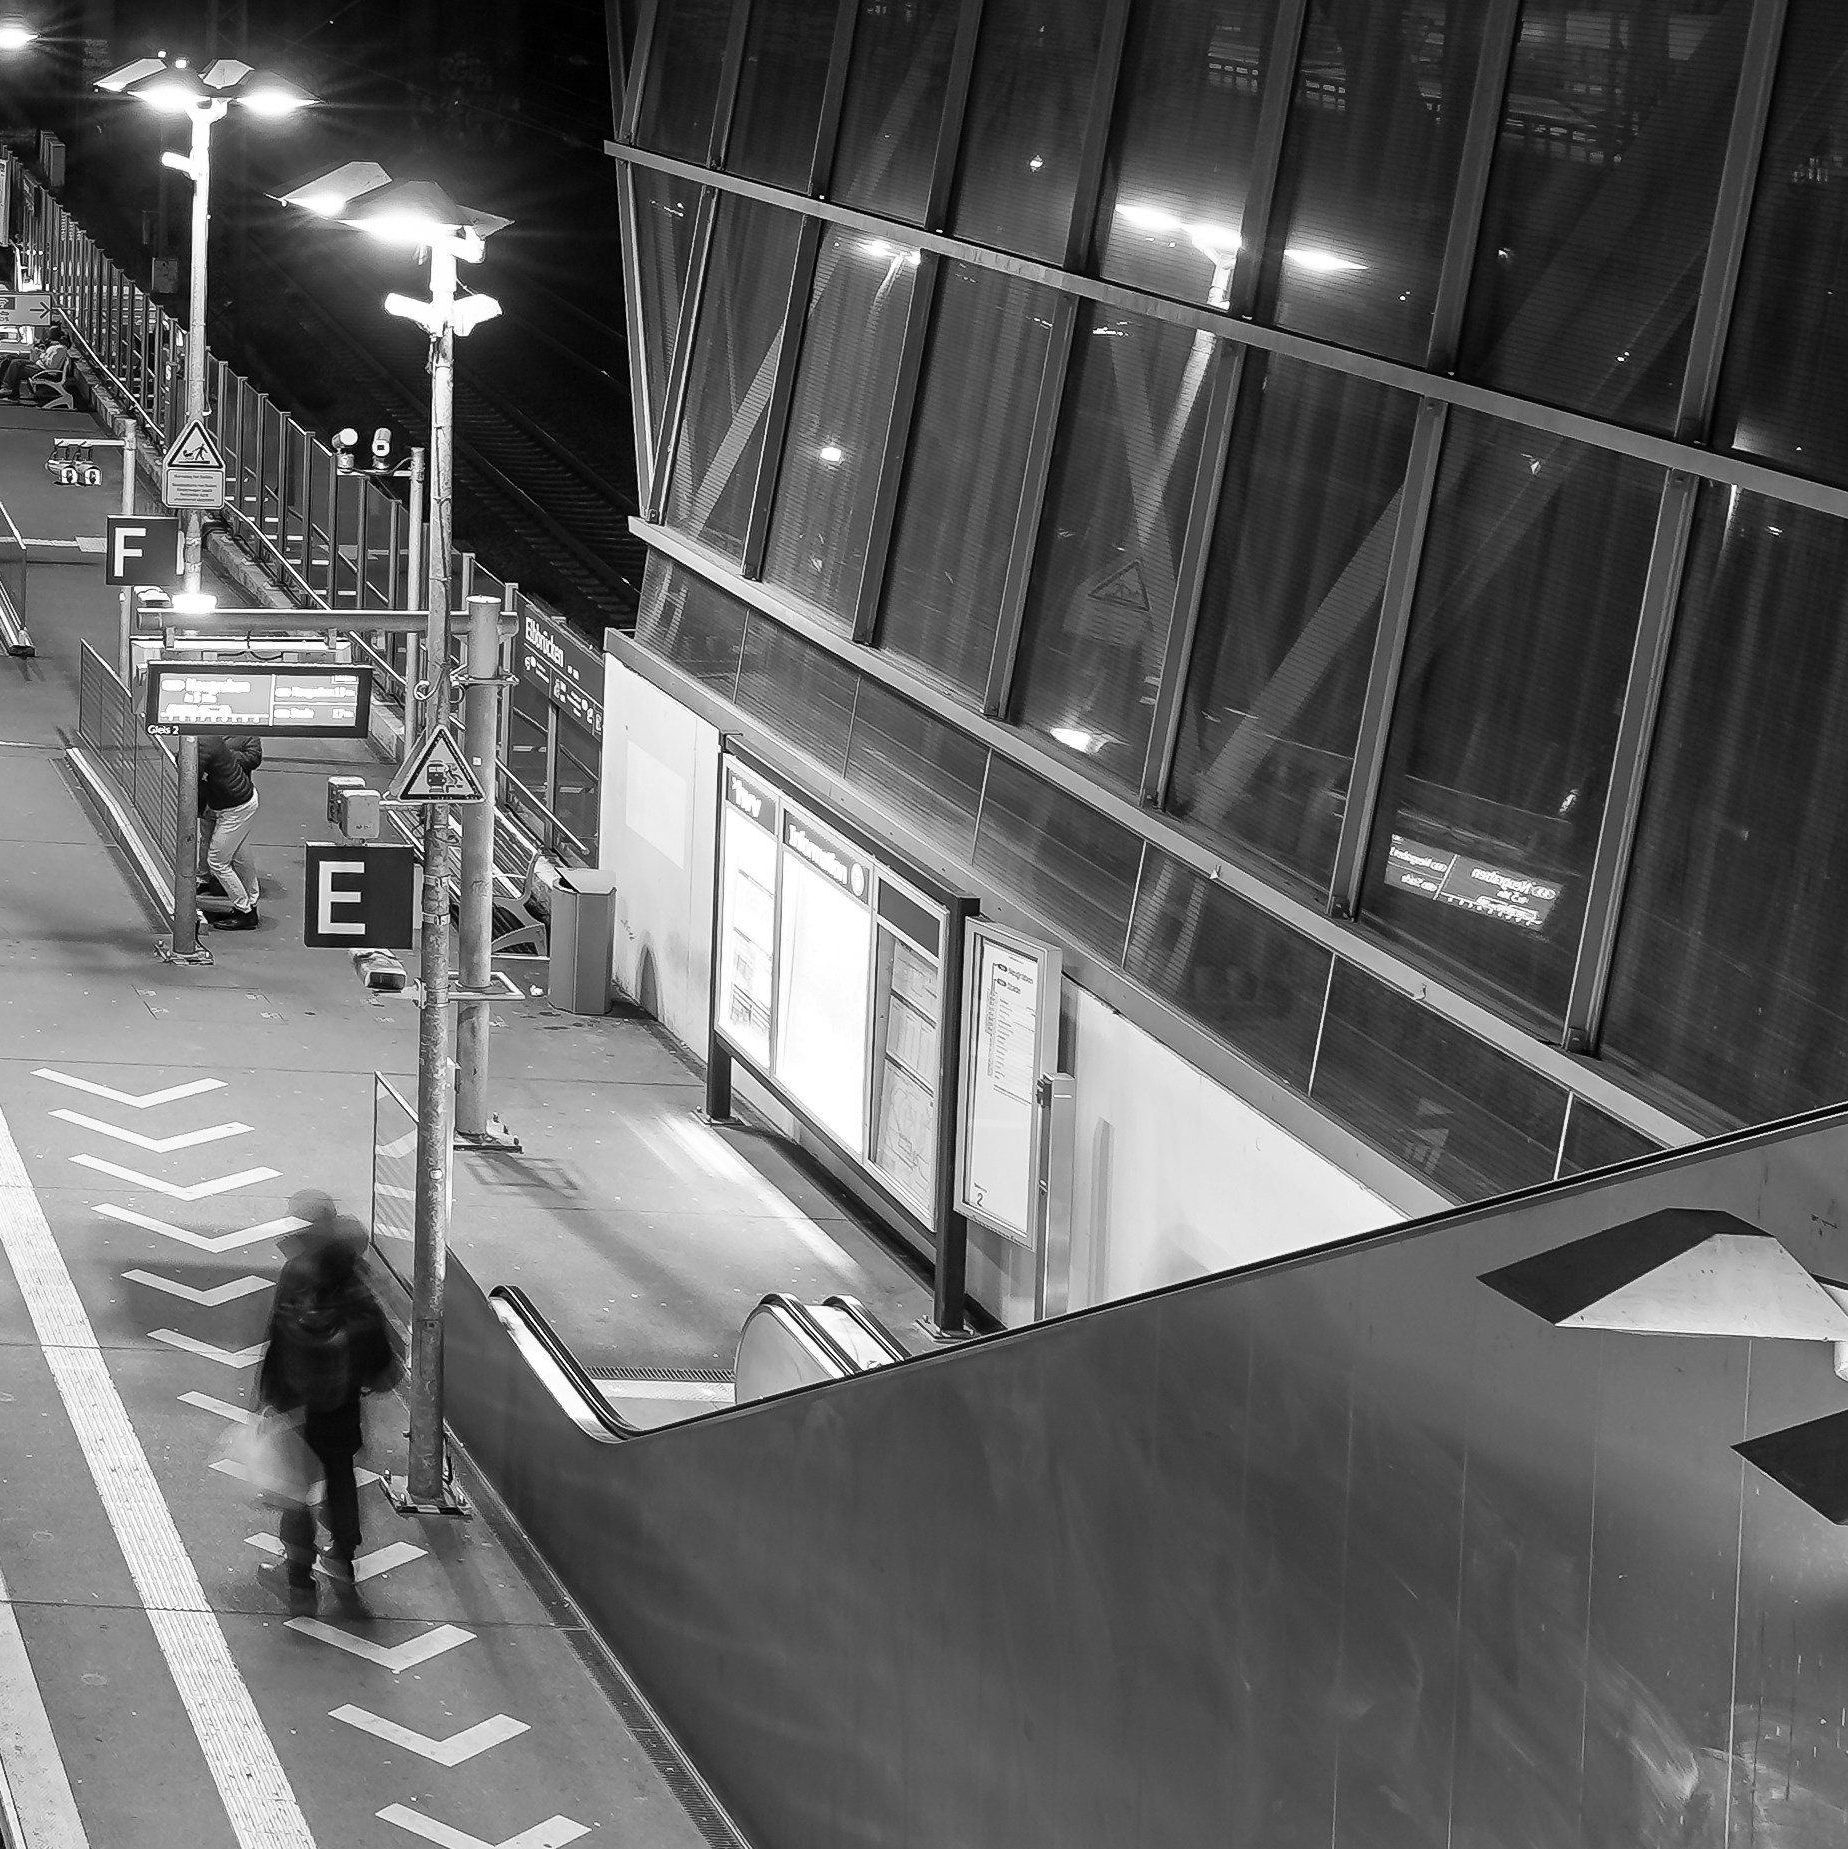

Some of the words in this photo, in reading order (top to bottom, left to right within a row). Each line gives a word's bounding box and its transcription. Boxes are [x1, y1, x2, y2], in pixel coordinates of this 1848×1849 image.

[113, 527, 147, 578] F
[147, 724, 171, 735] Gleis
[172, 726, 180, 735] 2
[317, 860, 367, 935] E
[976, 1192, 984, 1207] 2
